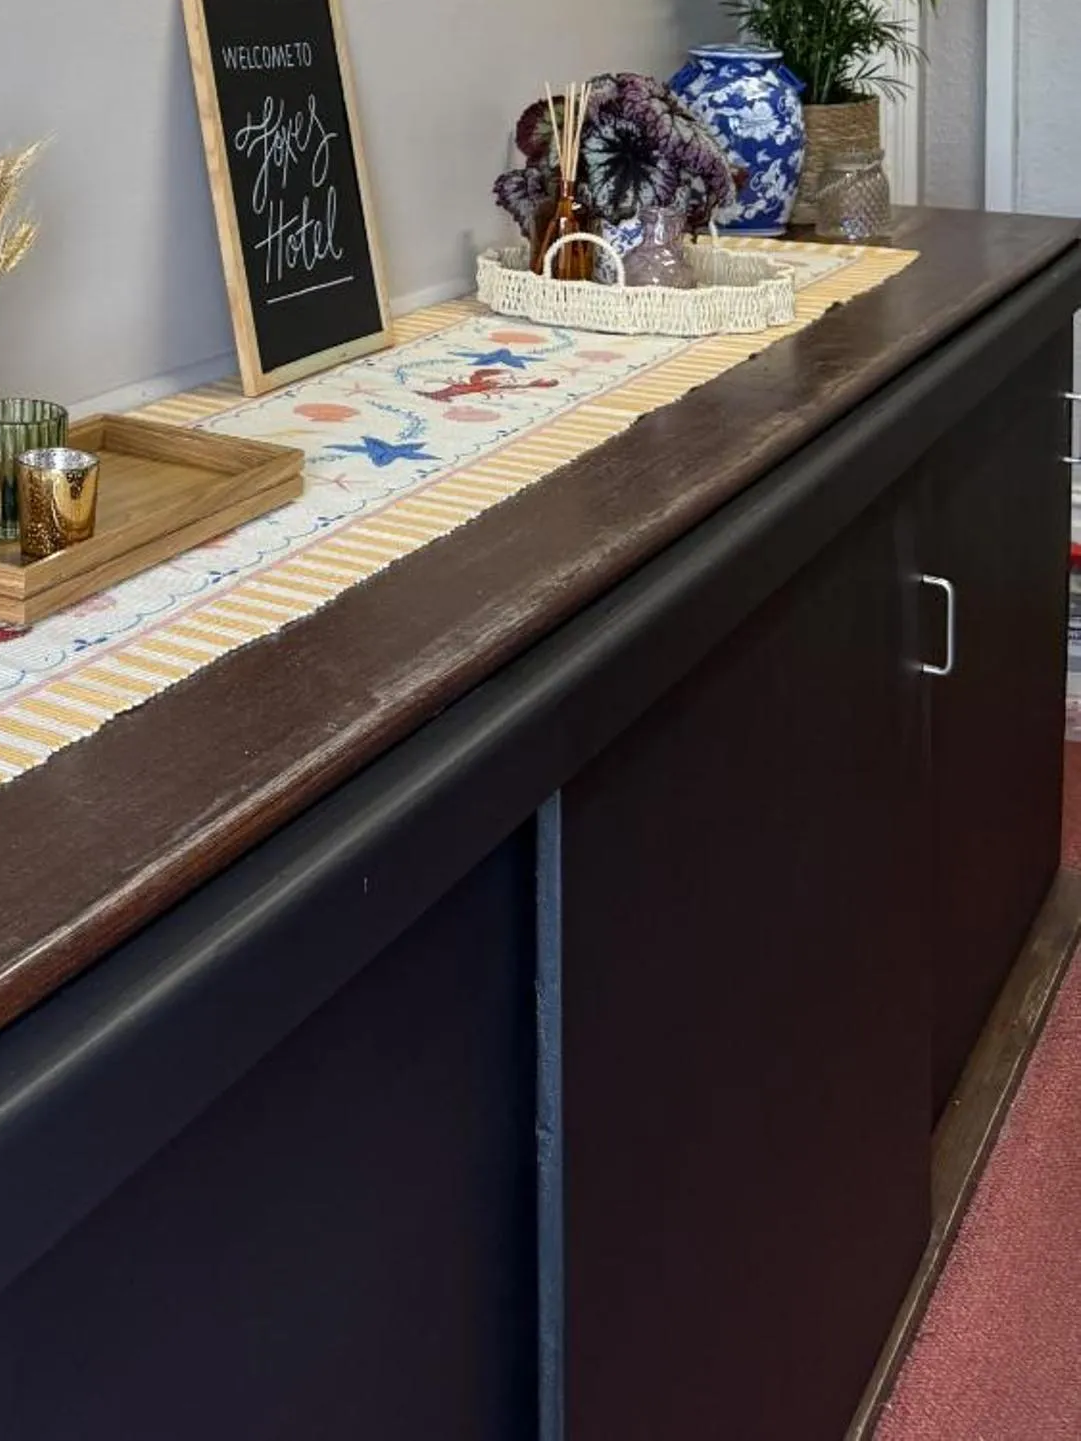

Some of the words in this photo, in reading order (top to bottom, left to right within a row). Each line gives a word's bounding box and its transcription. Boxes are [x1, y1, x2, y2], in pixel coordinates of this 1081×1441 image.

[222, 44, 294, 70] WELCOME
[293, 42, 313, 67] TO
[235, 93, 338, 214] Foxes
[254, 186, 343, 284] Hotel
